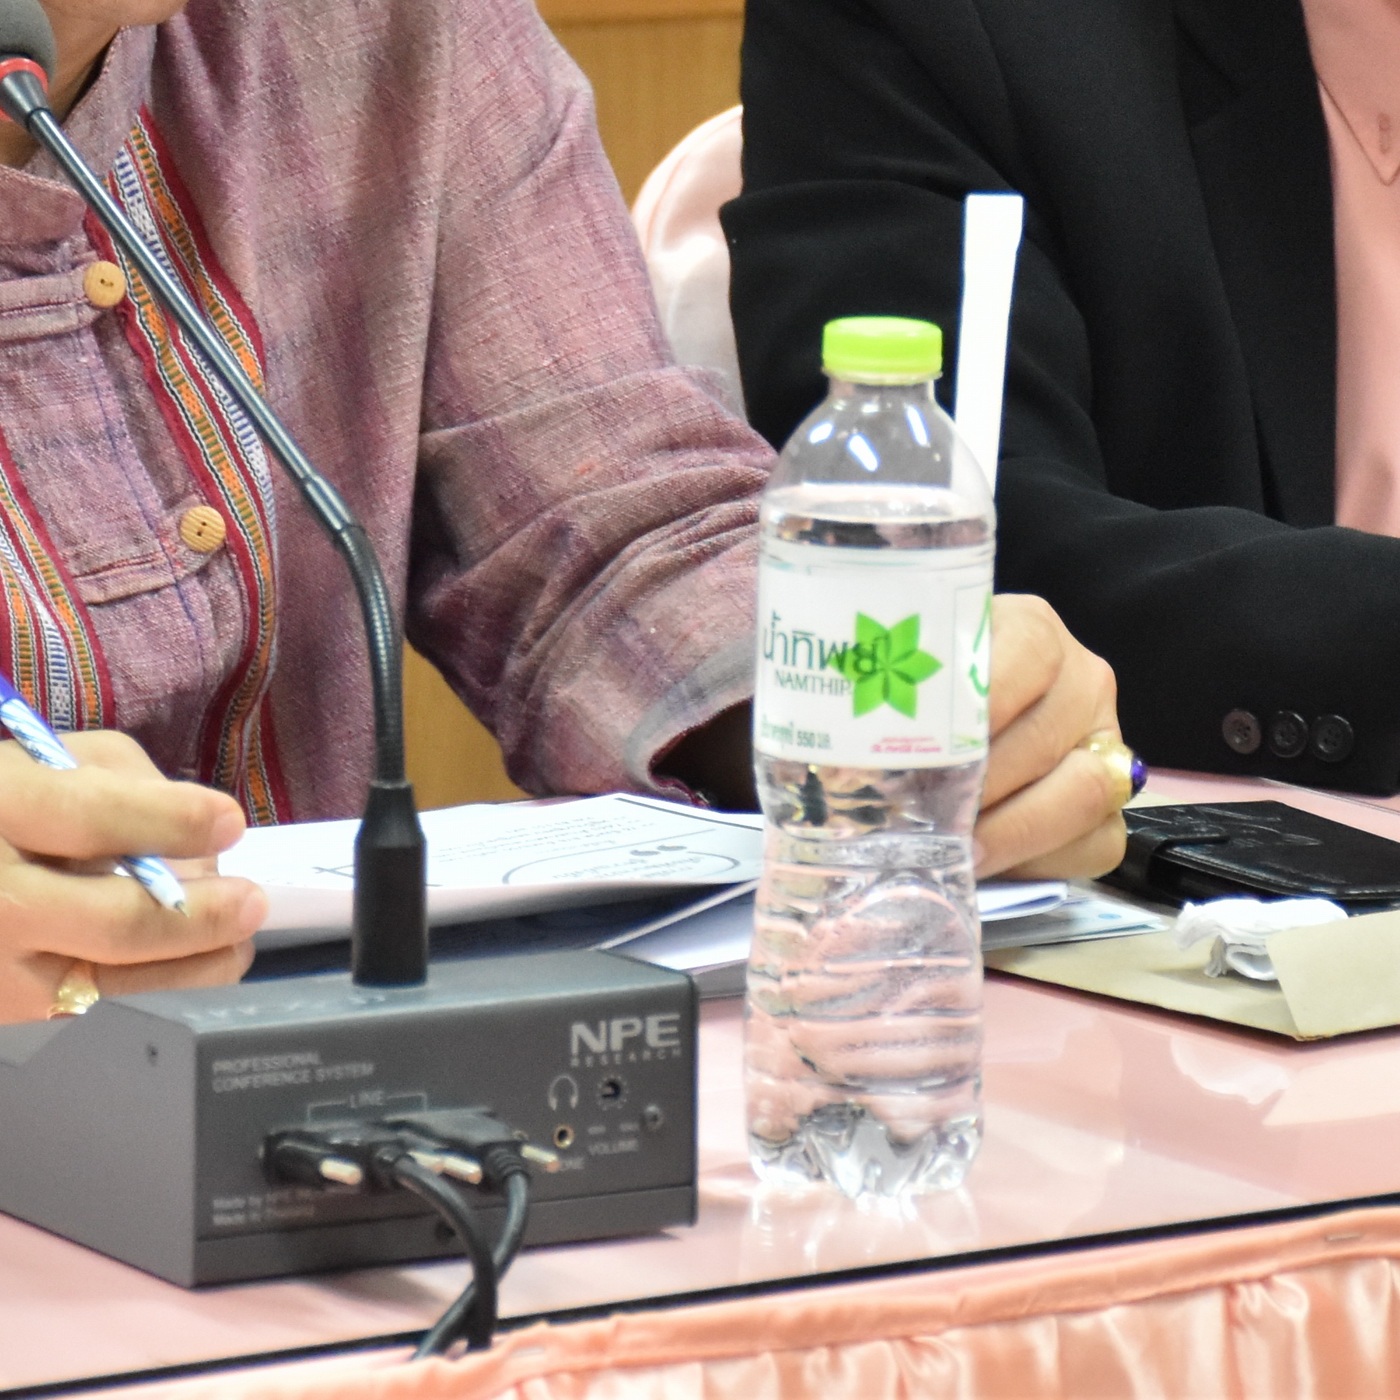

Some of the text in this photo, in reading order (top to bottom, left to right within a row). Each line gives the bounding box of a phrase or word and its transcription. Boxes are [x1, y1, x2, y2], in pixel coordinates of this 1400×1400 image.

[776, 669, 852, 696] NAMTHIP
[571, 1013, 681, 1056] NPE
[212, 1052, 321, 1075] PROFESSIONAL
[212, 1069, 310, 1094] CONFERENCE
[350, 1090, 386, 1108] LINE
